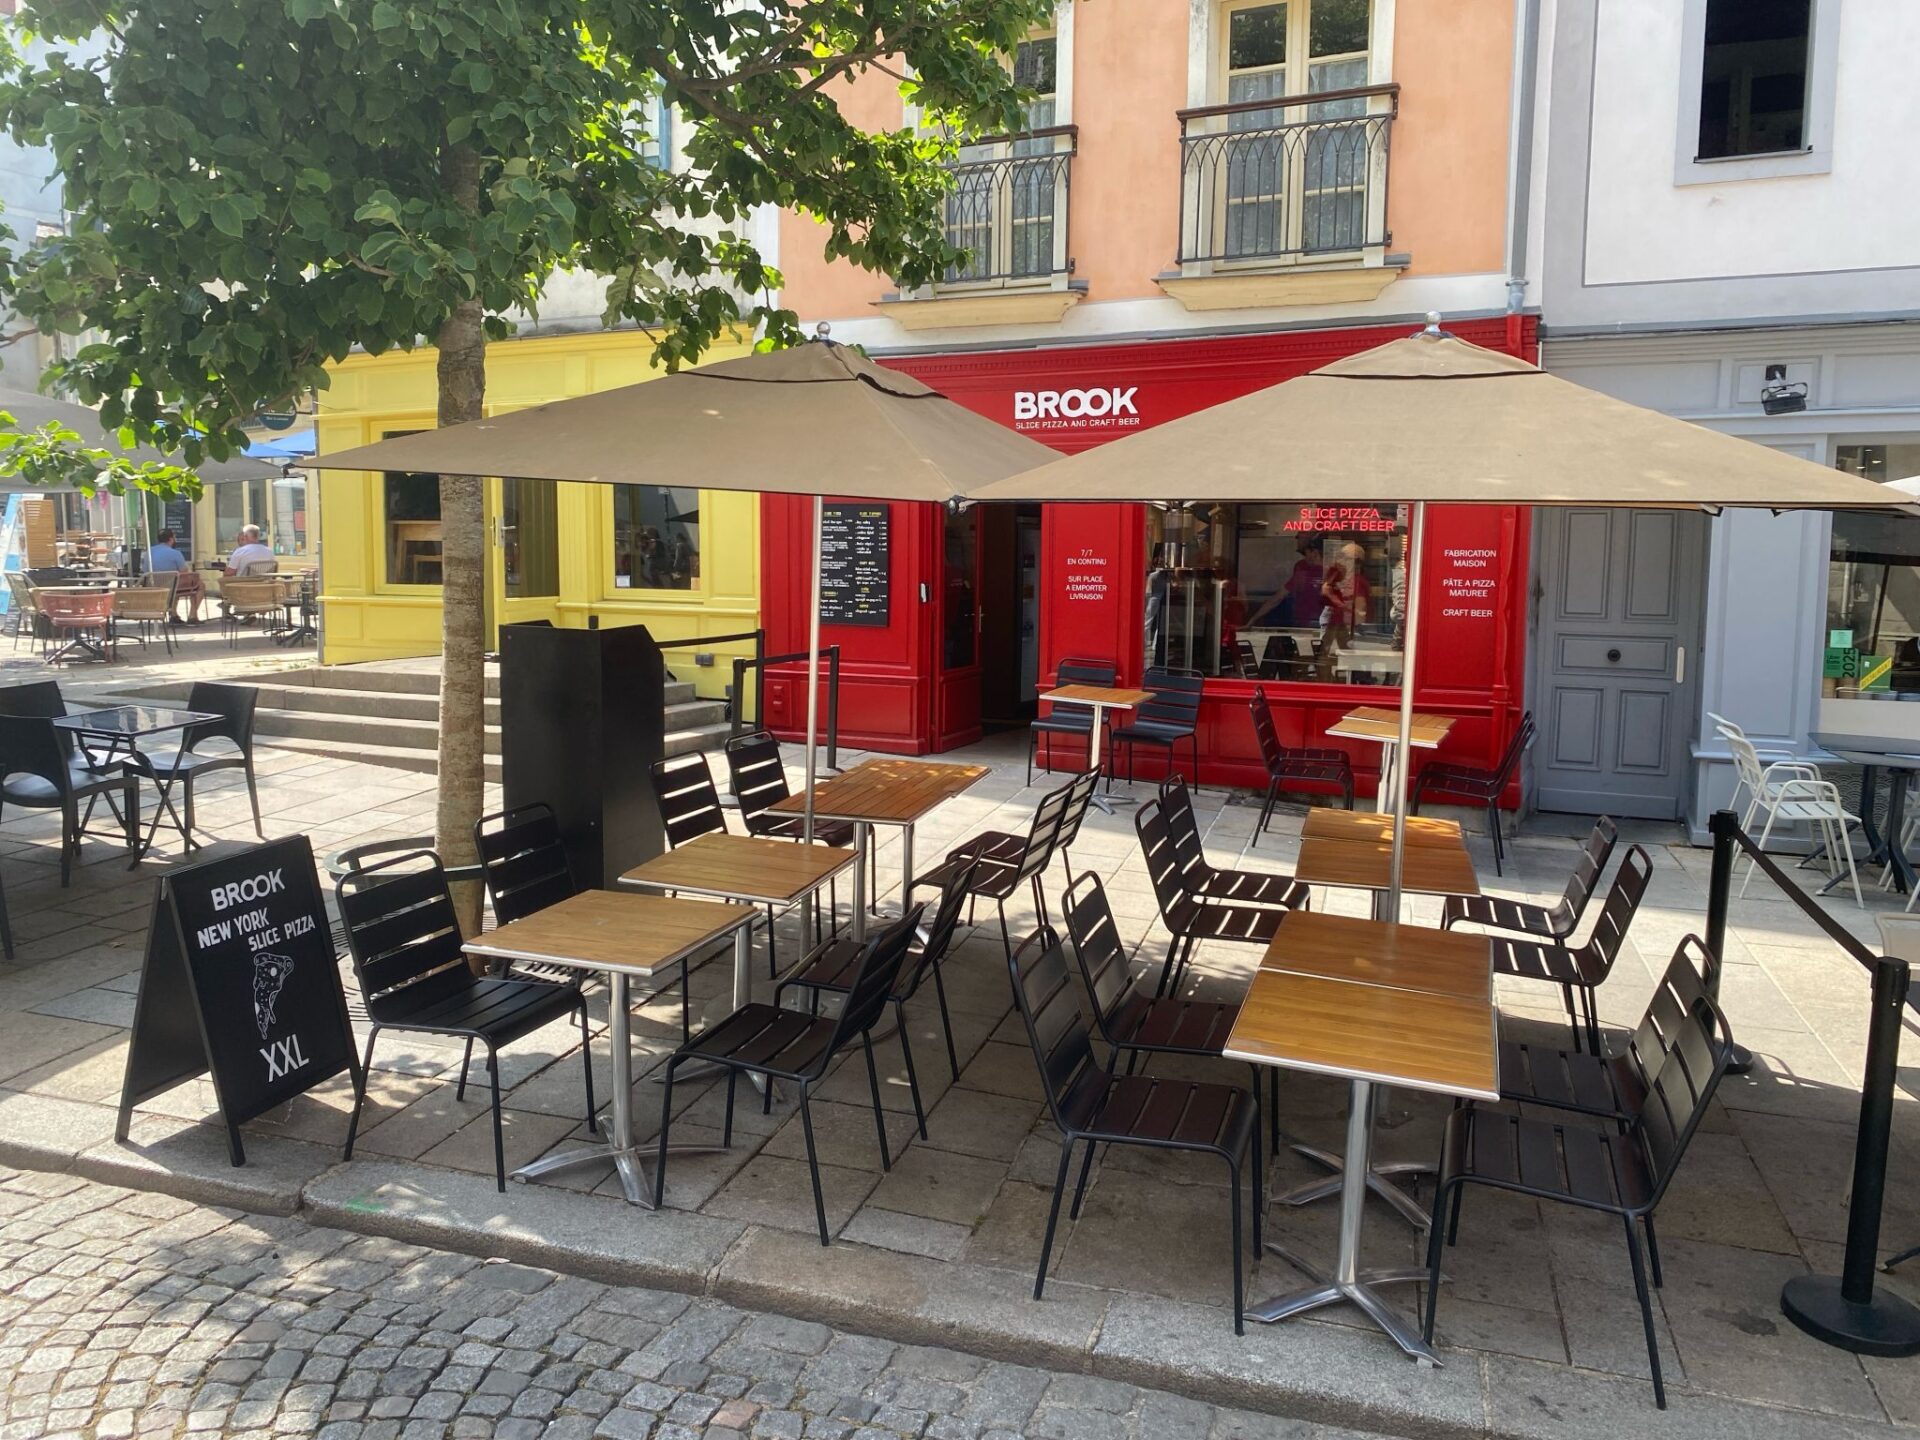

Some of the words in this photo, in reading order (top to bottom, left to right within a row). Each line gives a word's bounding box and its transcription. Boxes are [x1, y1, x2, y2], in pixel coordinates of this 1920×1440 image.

[1014, 387, 1138, 420] BROOK
[1016, 422, 1040, 430] SLICE
[1042, 421, 1068, 429] PIZZA
[1090, 419, 1115, 427] CRAFT
[1118, 417, 1140, 426] BEER
[1300, 508, 1336, 519] SLICE
[1339, 508, 1380, 519] PIZZA
[1283, 520, 1313, 531] AND
[1314, 520, 1359, 531] CRAFT
[1359, 520, 1394, 531] BEER
[1081, 549, 1093, 557] 7/7
[1444, 549, 1497, 558] FABRICATION
[1071, 584, 1107, 592] EMPORTER
[1443, 577, 1463, 587] PÂTE
[1472, 579, 1496, 588] PIZZA
[1442, 609, 1468, 617] CRAFT
[1470, 609, 1493, 618] BEER
[1842, 648, 1856, 679] 2025
[210, 868, 286, 912] BROOK
[196, 919, 232, 949] NEW
[234, 907, 270, 936] YORK
[247, 927, 281, 952] SLICE
[284, 914, 316, 941] PIZZA
[259, 1033, 310, 1083] XXL
